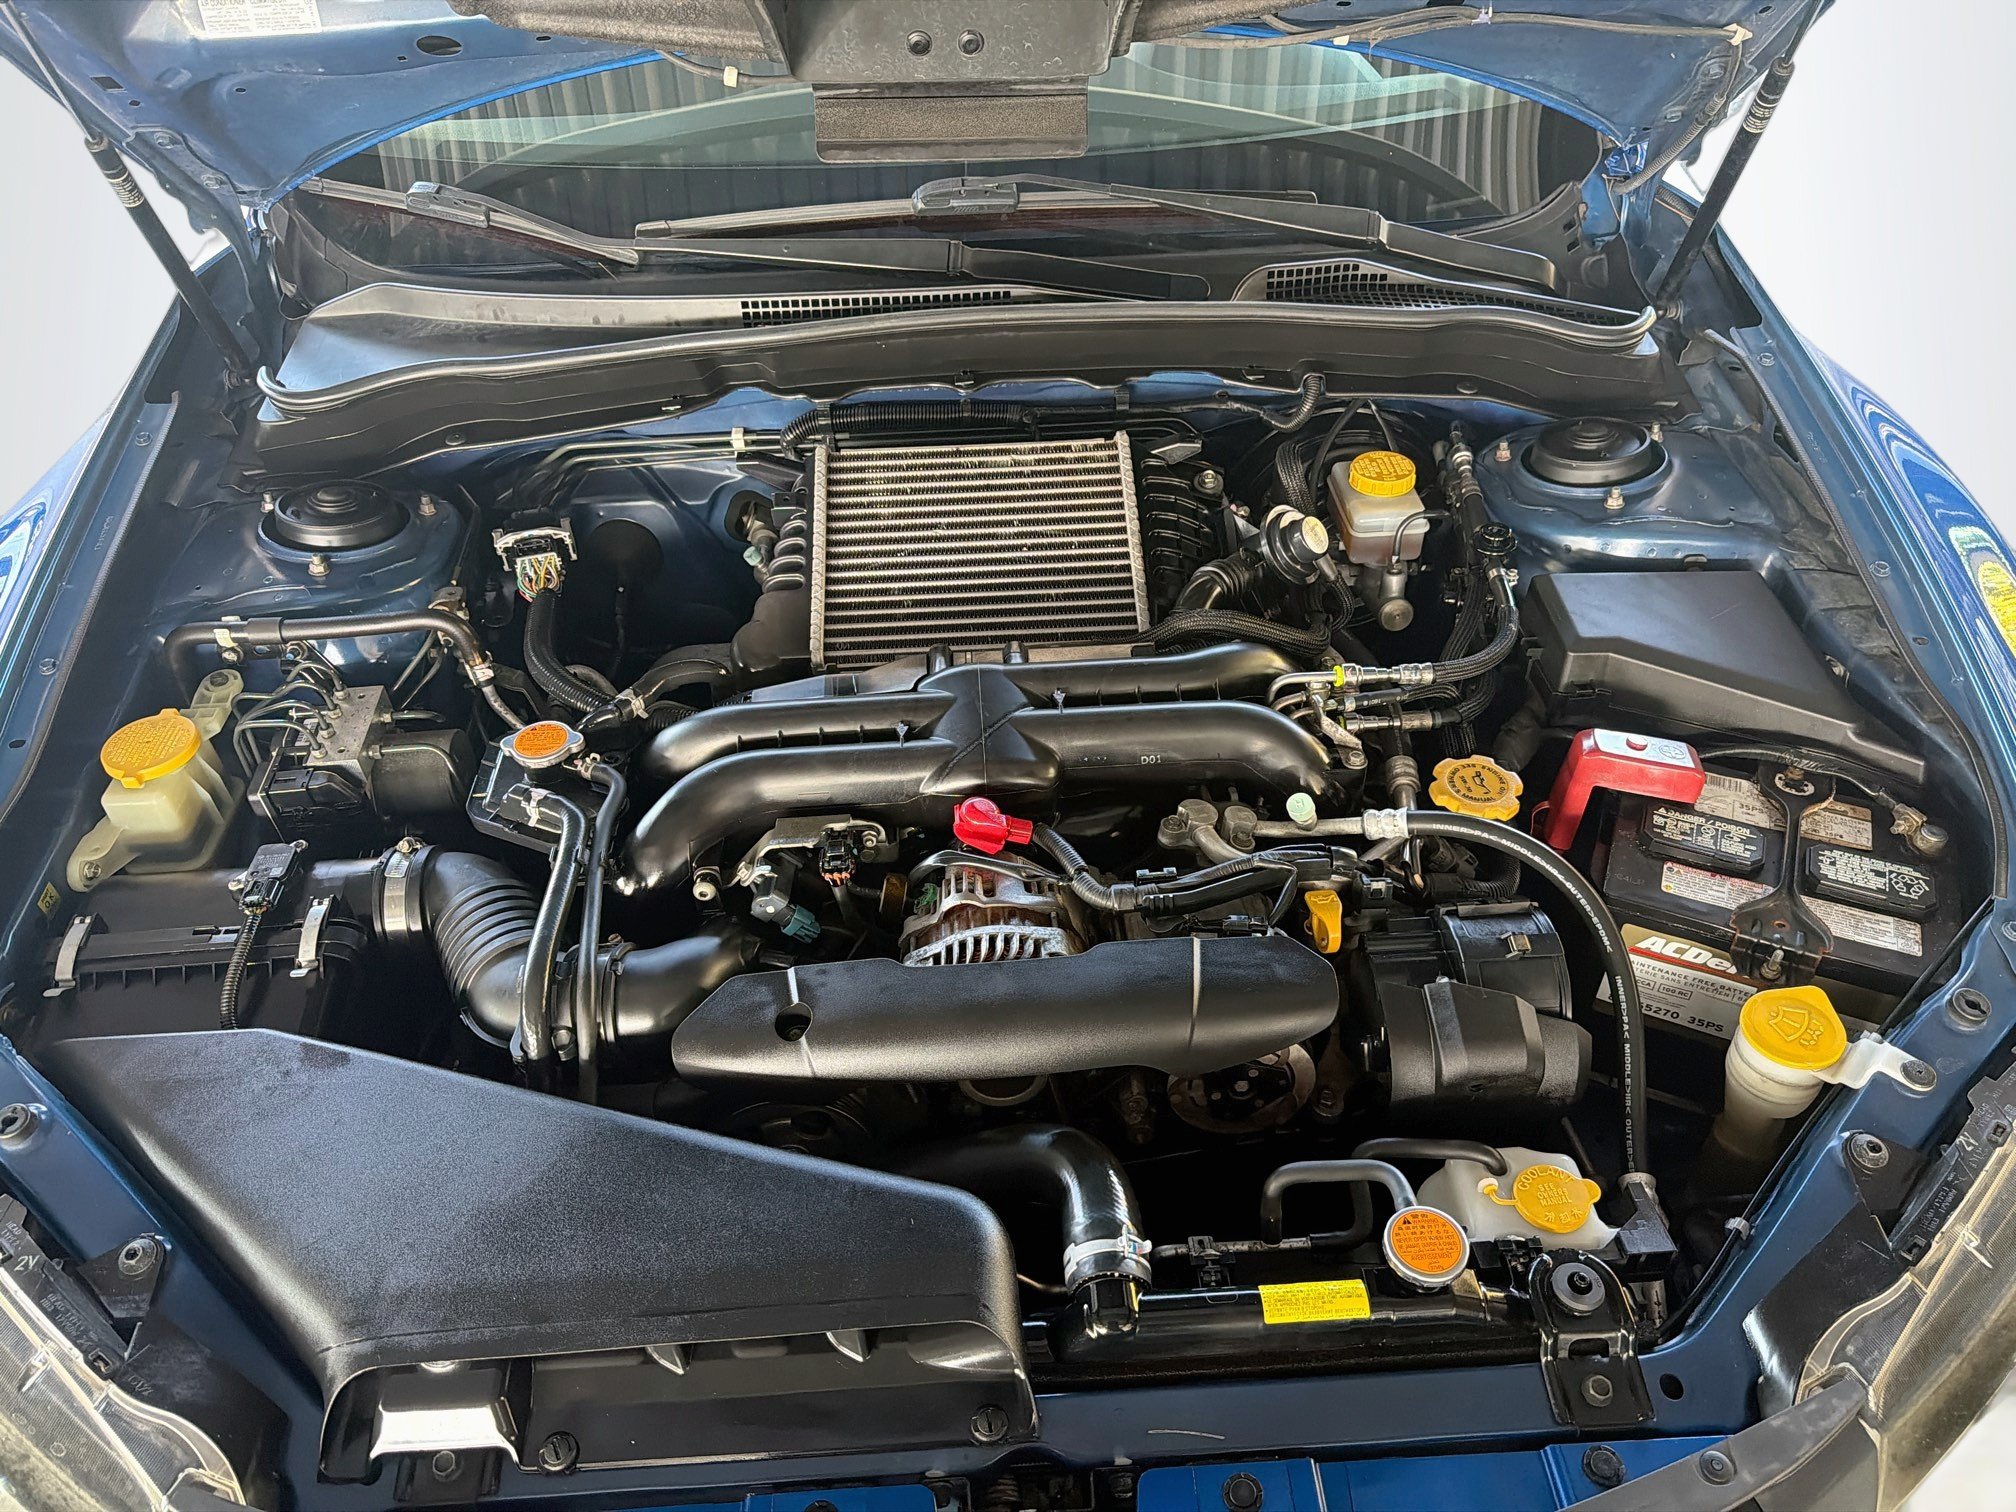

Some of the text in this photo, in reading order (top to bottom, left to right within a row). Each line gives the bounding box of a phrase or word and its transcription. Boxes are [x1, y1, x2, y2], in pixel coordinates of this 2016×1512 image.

[1141, 755, 1161, 765] D01
[1481, 765, 1506, 785] ENGINE
[1461, 792, 1497, 803] MANUAL
[1715, 820, 1751, 835] POISON
[1631, 960, 1690, 981] AINTENANCE
[1719, 984, 1750, 997] BATTE
[1662, 986, 1677, 994] 100
[1678, 990, 1690, 998] RC
[1687, 1016, 1725, 1032] 35PS
[1517, 1166, 1577, 1191] COOLANT
[1538, 1182, 1554, 1192] SEE
[1540, 1196, 1573, 1207] MANUAL
